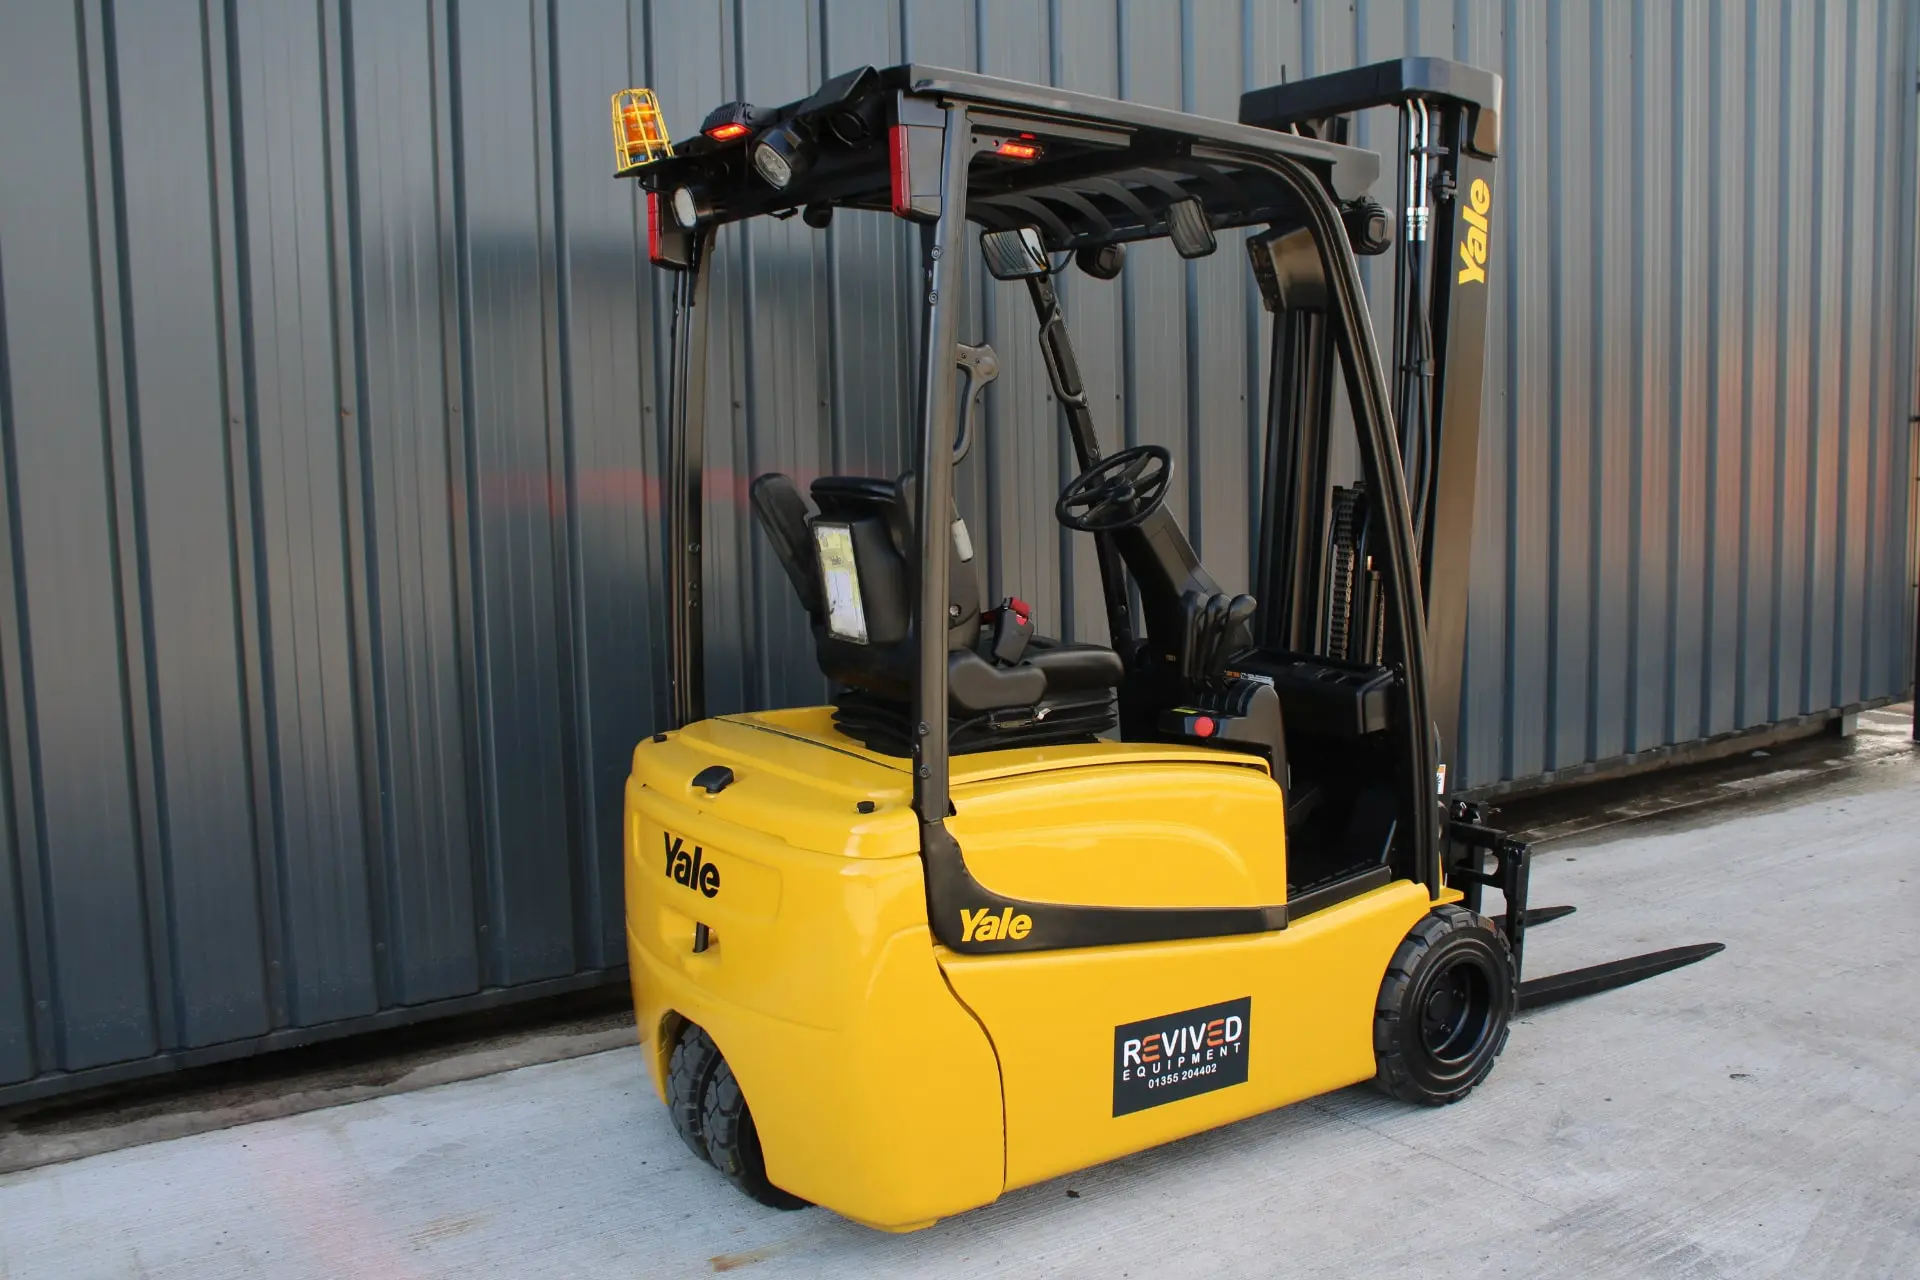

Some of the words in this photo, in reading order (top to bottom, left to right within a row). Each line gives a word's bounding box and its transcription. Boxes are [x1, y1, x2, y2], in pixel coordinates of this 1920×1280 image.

[1459, 178, 1490, 284] Yale
[664, 831, 720, 898] Yale
[960, 906, 1032, 942] Yale
[1122, 1042, 1241, 1081] EQUIPMENT
[1123, 1015, 1242, 1067] REVIVED
[1148, 1073, 1179, 1089] 01355
[1182, 1063, 1217, 1081] 204402
